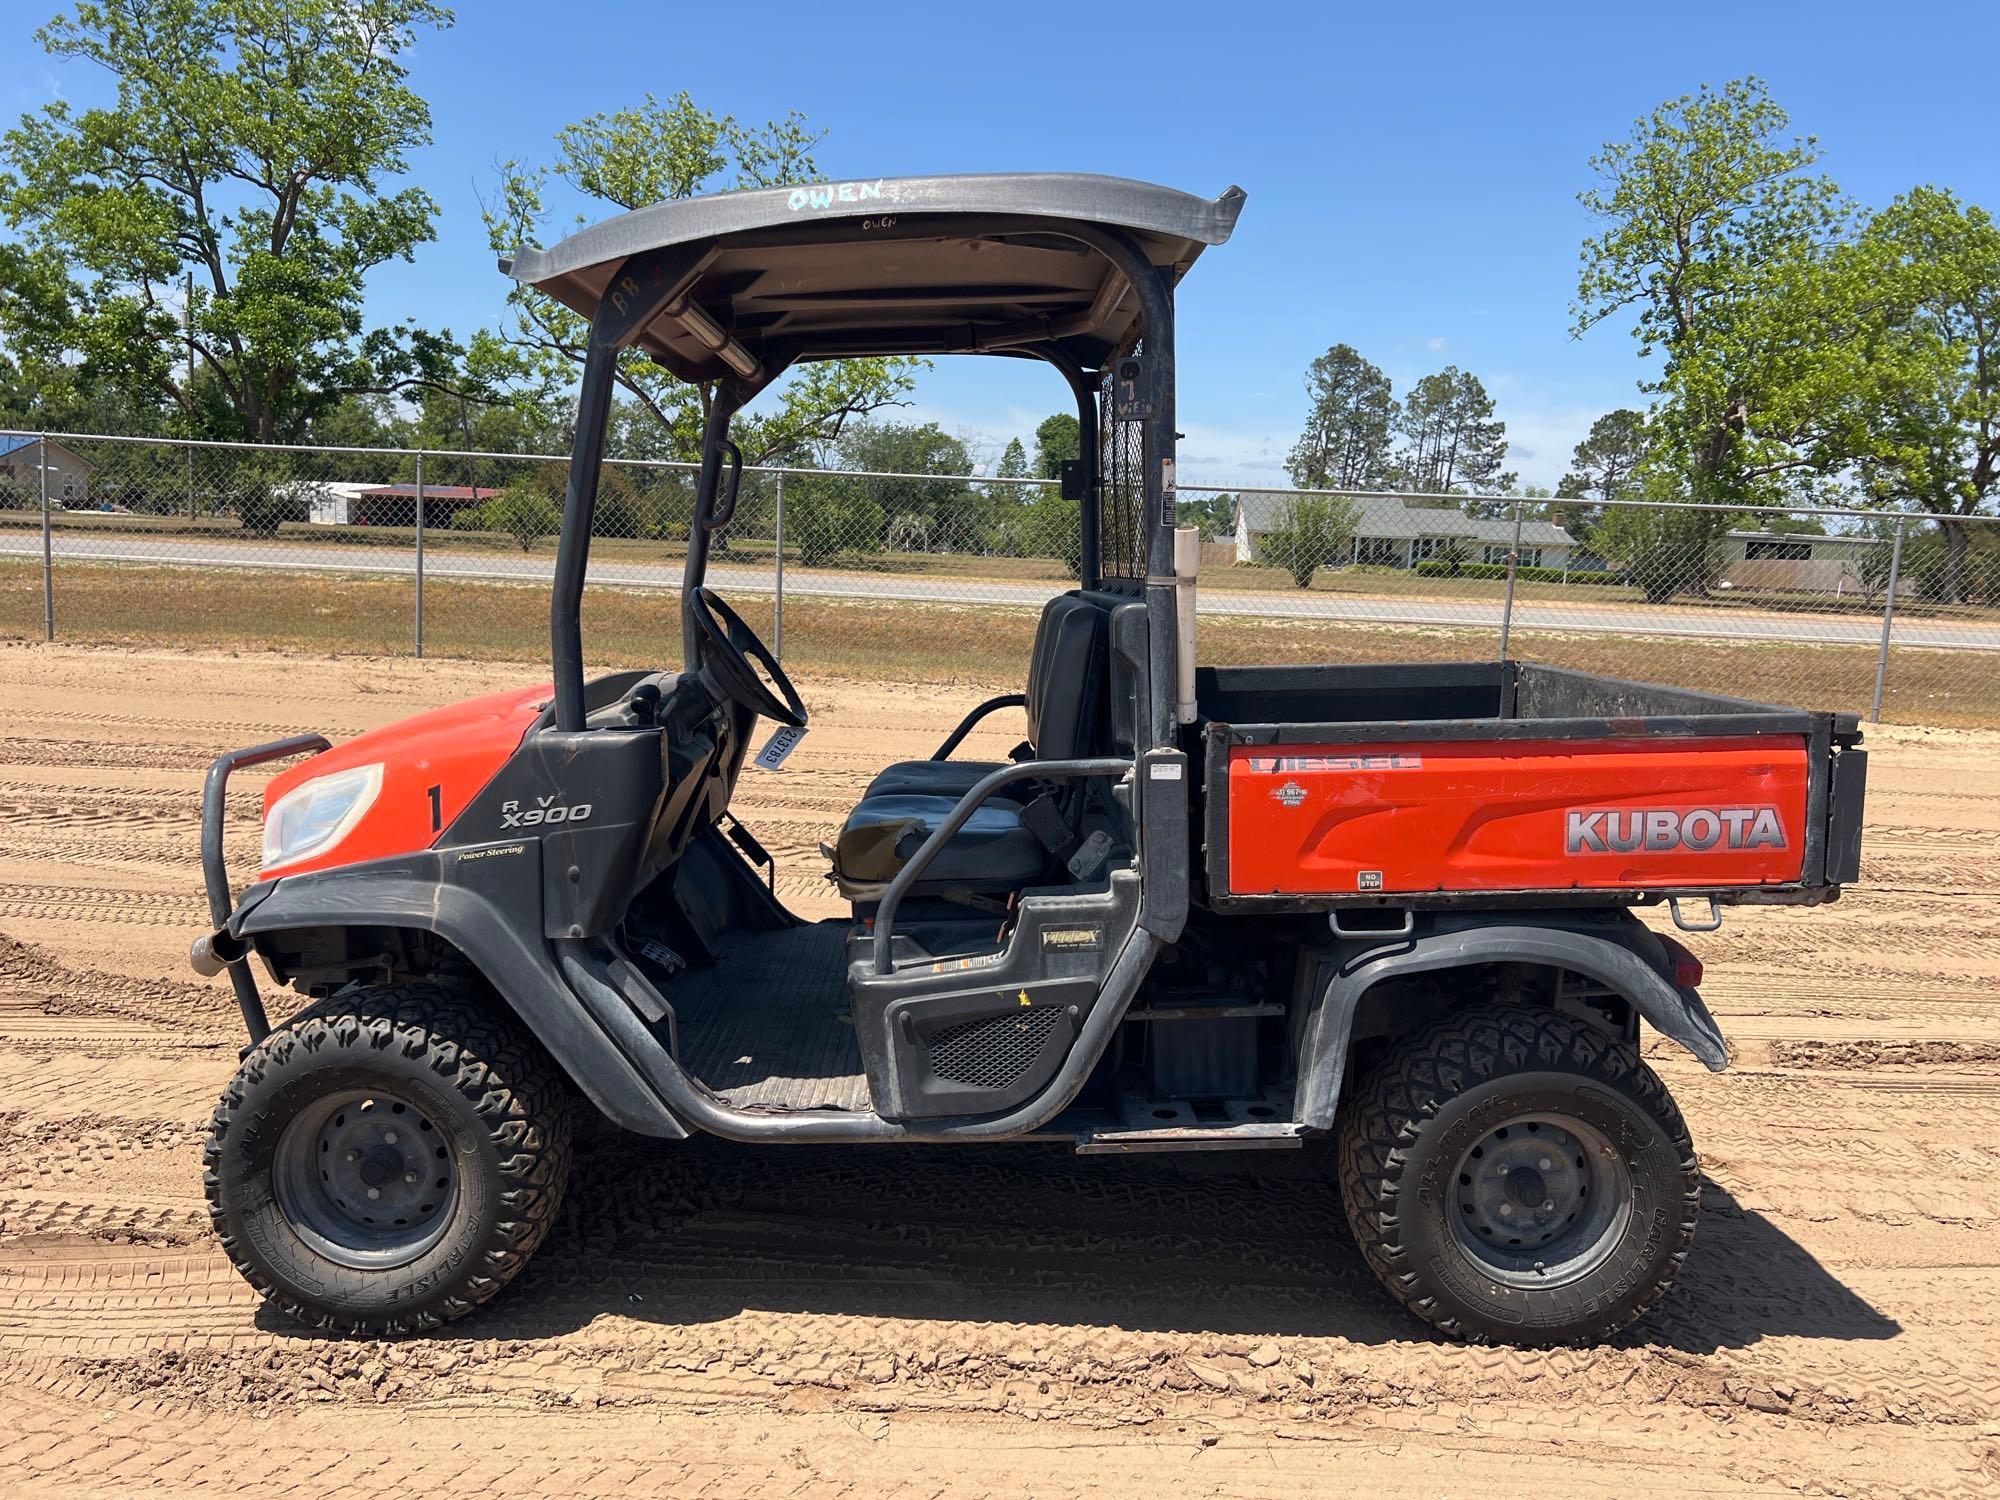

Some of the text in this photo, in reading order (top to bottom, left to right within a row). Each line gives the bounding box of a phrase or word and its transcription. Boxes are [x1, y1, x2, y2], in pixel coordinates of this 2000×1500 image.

[788, 179, 883, 211] OWEN
[863, 216, 896, 230] OWEN
[765, 730, 797, 763] 213783
[427, 784, 441, 833] 1
[500, 804, 592, 829] X900
[1568, 808, 1787, 853] KUBOTA
[458, 845, 524, 860] Power Steering
[384, 1213, 480, 1305] CARLISLE
[1583, 1206, 1669, 1315] CARLISLE
